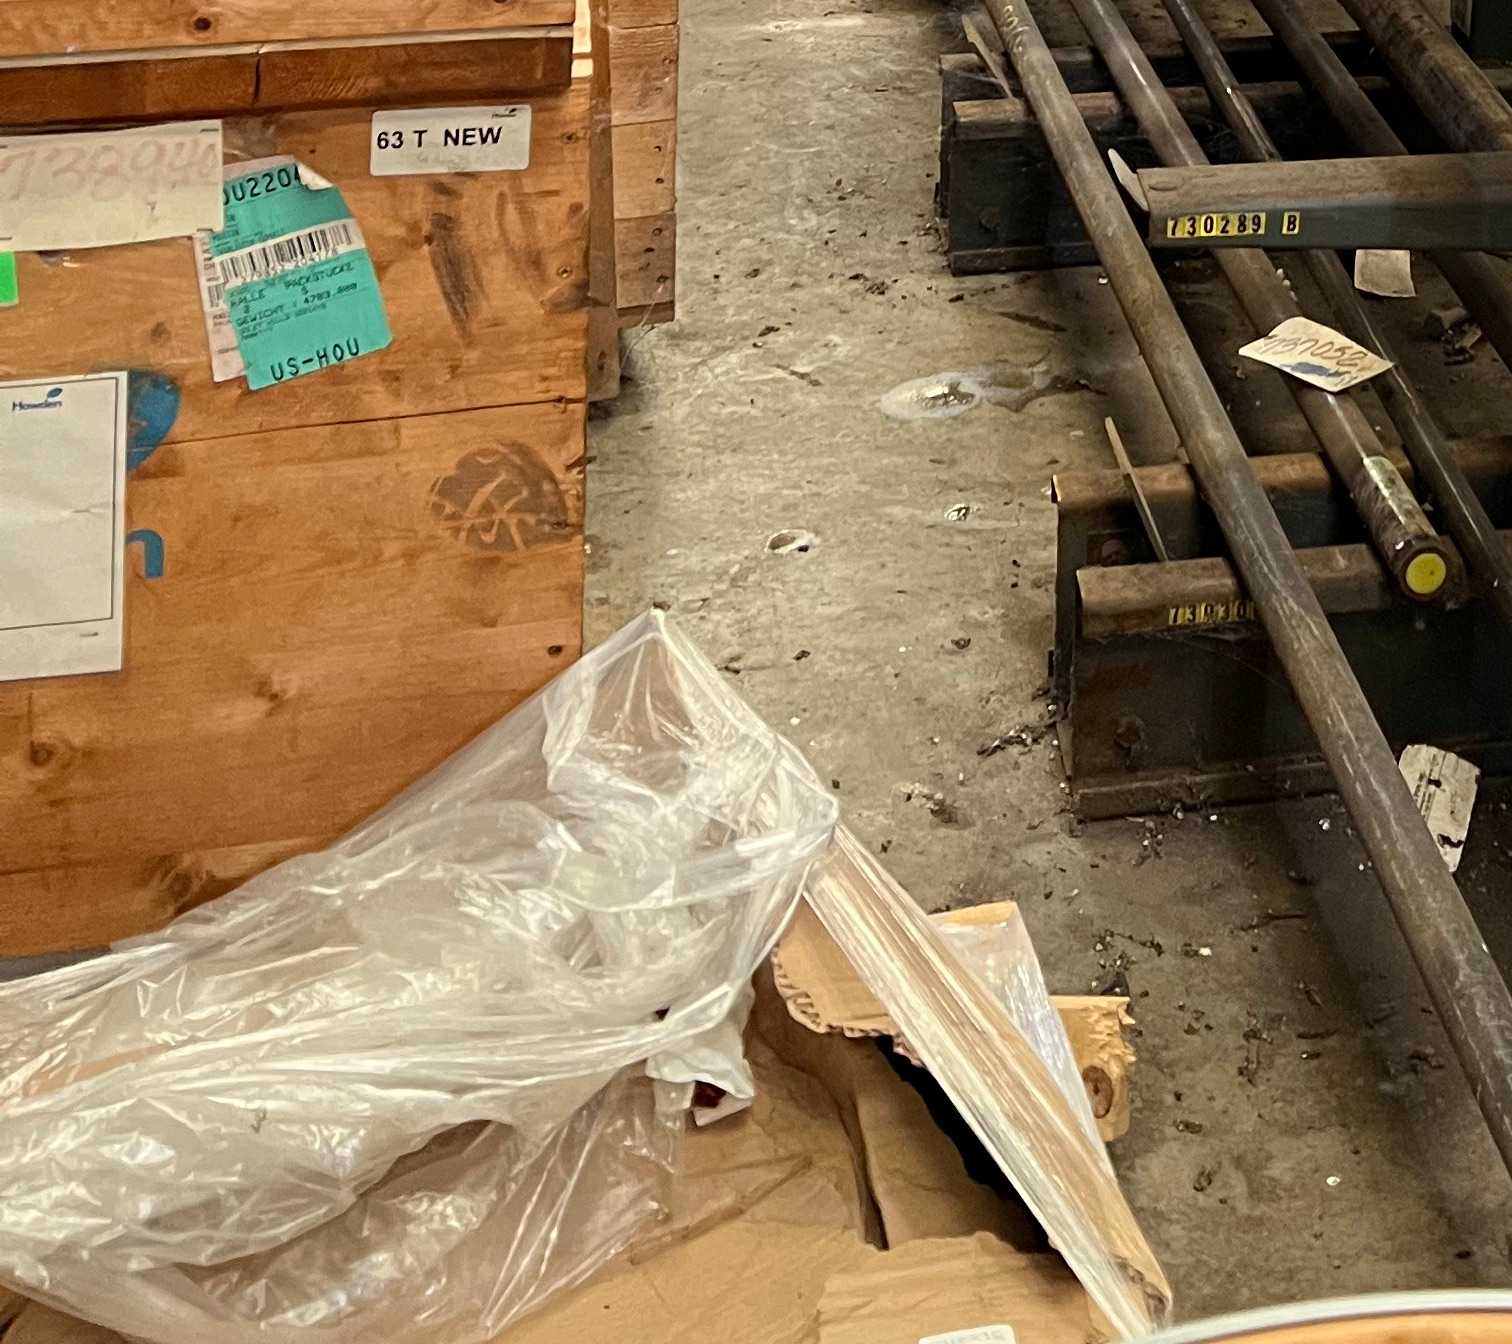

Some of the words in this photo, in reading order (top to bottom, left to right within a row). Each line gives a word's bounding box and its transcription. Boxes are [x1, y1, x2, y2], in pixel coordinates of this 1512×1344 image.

[376, 130, 404, 150] 63
[413, 129, 428, 148] T
[443, 126, 503, 147] NEW
[1169, 213, 1262, 237] 730289
[1286, 213, 1298, 233] B
[270, 337, 360, 382] US-HOU
